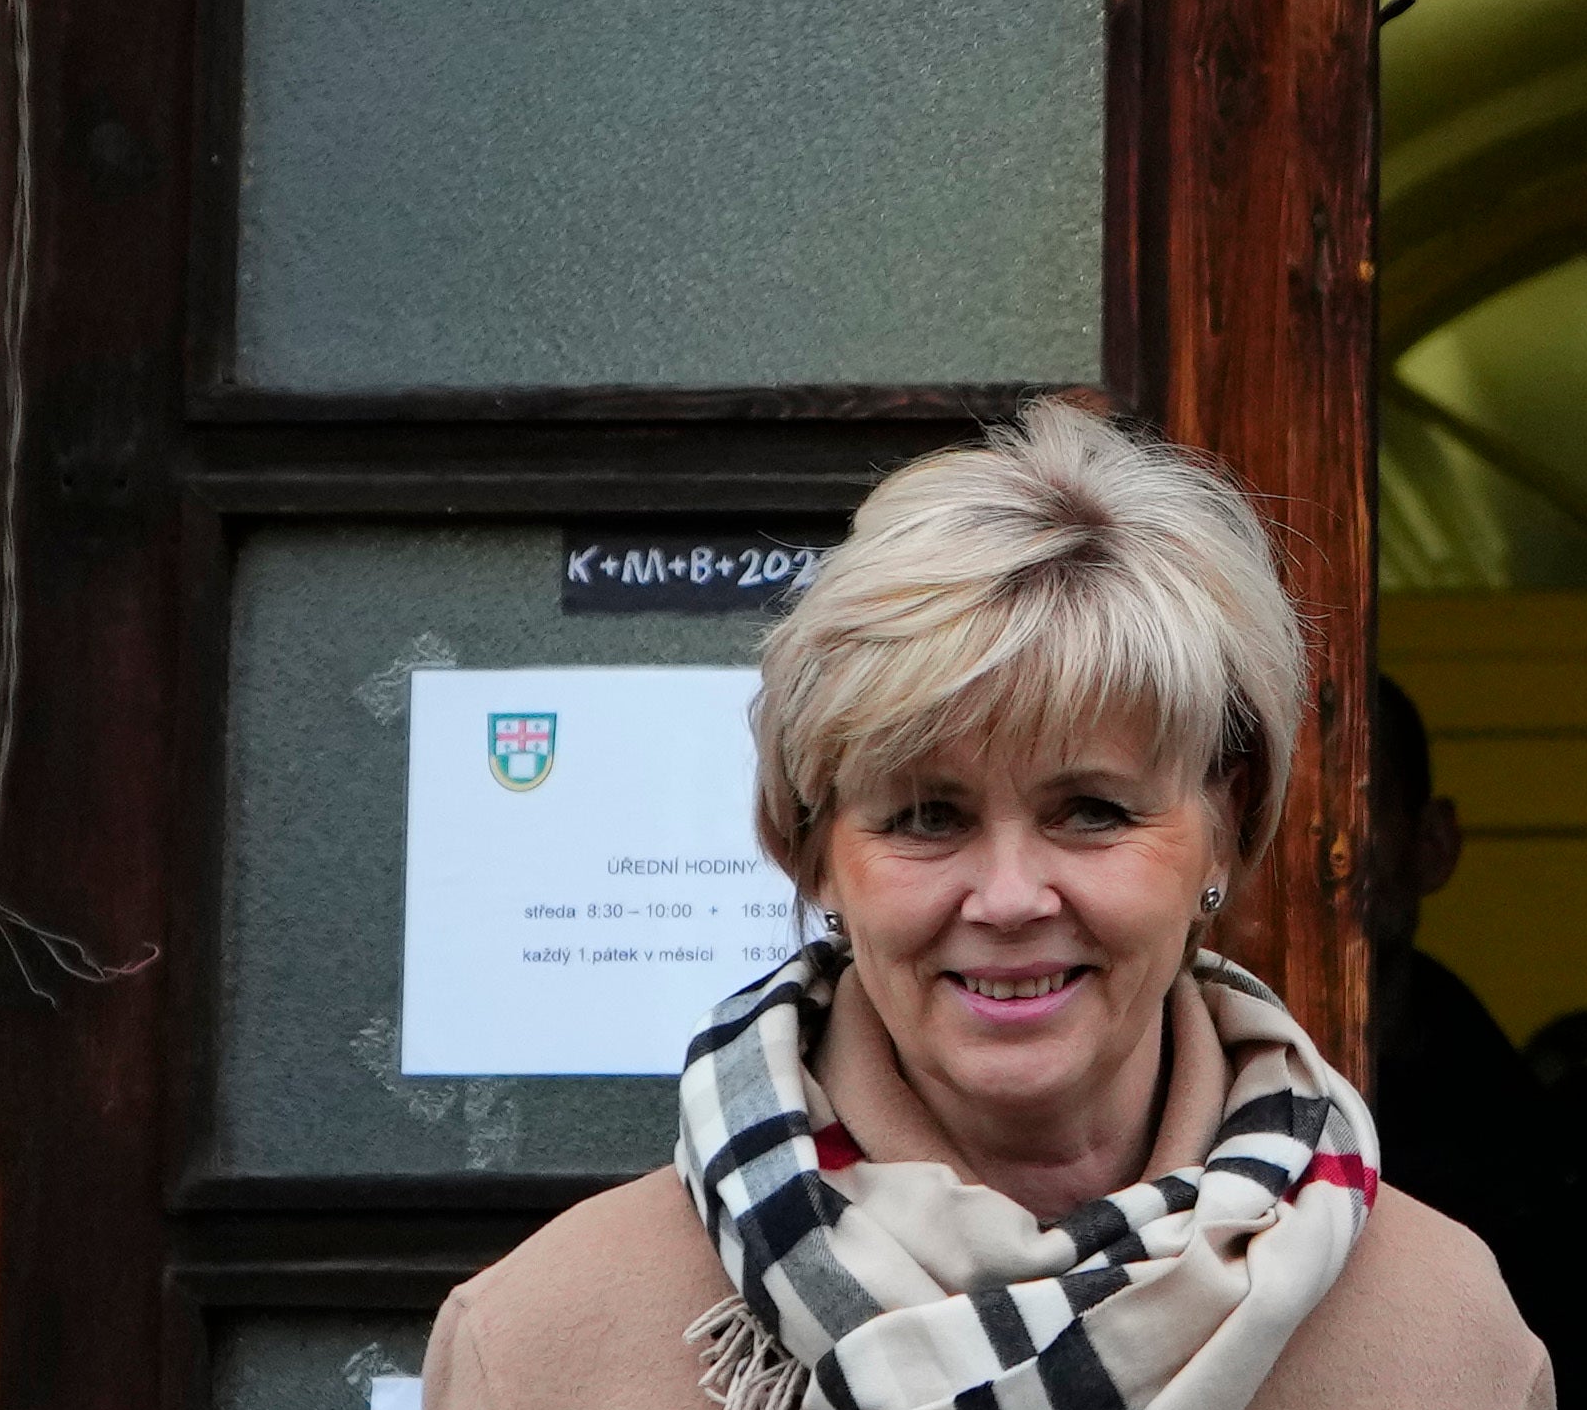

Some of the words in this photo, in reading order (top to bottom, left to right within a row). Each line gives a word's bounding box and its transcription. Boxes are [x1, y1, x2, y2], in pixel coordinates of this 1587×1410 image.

[567, 544, 817, 588] K+M+B+202
[607, 856, 679, 875] ÚŘEDNÍ
[524, 902, 576, 919] středa
[587, 904, 623, 918] 8:30
[646, 904, 692, 918] 10:00
[741, 904, 788, 918] 16:30
[523, 947, 570, 966] každý
[644, 951, 653, 962] v
[659, 947, 714, 962] měsíci
[741, 947, 788, 962] 16:30
